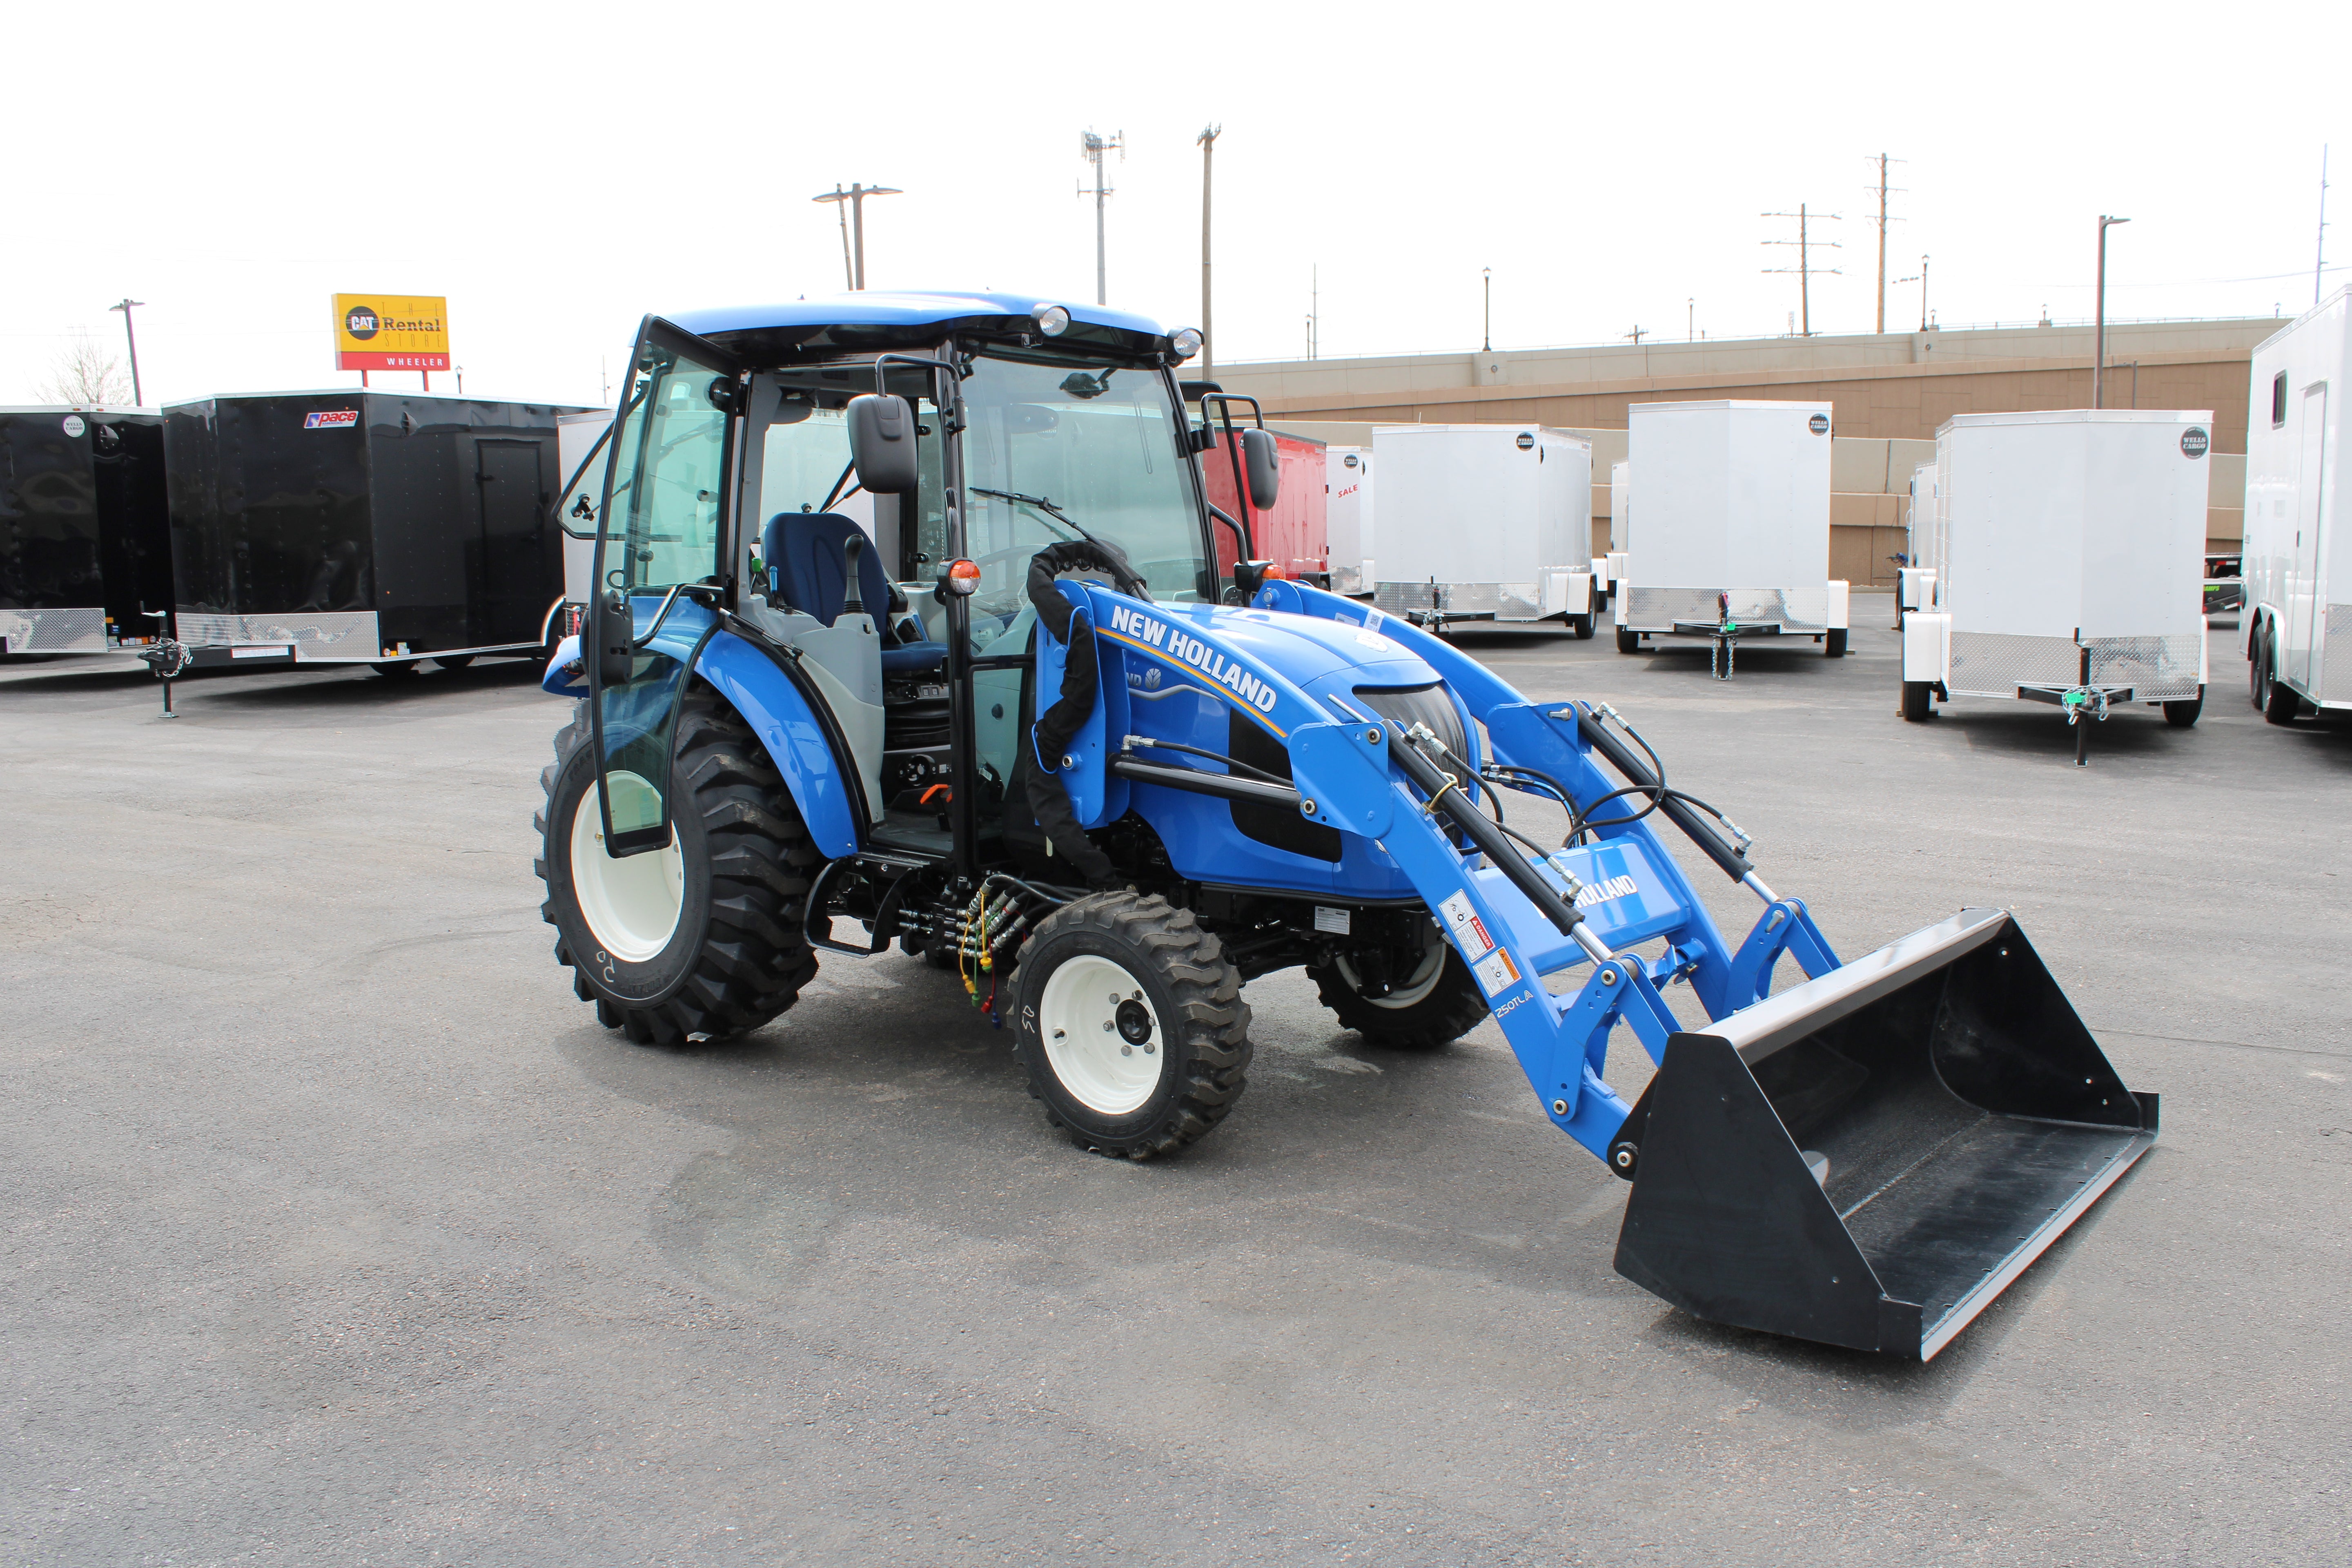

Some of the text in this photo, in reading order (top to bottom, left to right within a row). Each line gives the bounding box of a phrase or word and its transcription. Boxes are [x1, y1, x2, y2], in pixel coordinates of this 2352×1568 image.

[382, 302, 439, 316] THE
[351, 315, 374, 331] CAT
[382, 317, 441, 332] Rental
[385, 334, 441, 347] STORE
[387, 358, 443, 366] WHEELER
[318, 412, 356, 427] pace
[1338, 483, 1358, 498] SALE
[1111, 605, 1277, 713] NEW HOLLAND
[1476, 924, 1491, 947] DANGER
[1504, 958, 1517, 977] WARNING
[1494, 990, 1534, 1018] 250TLA
